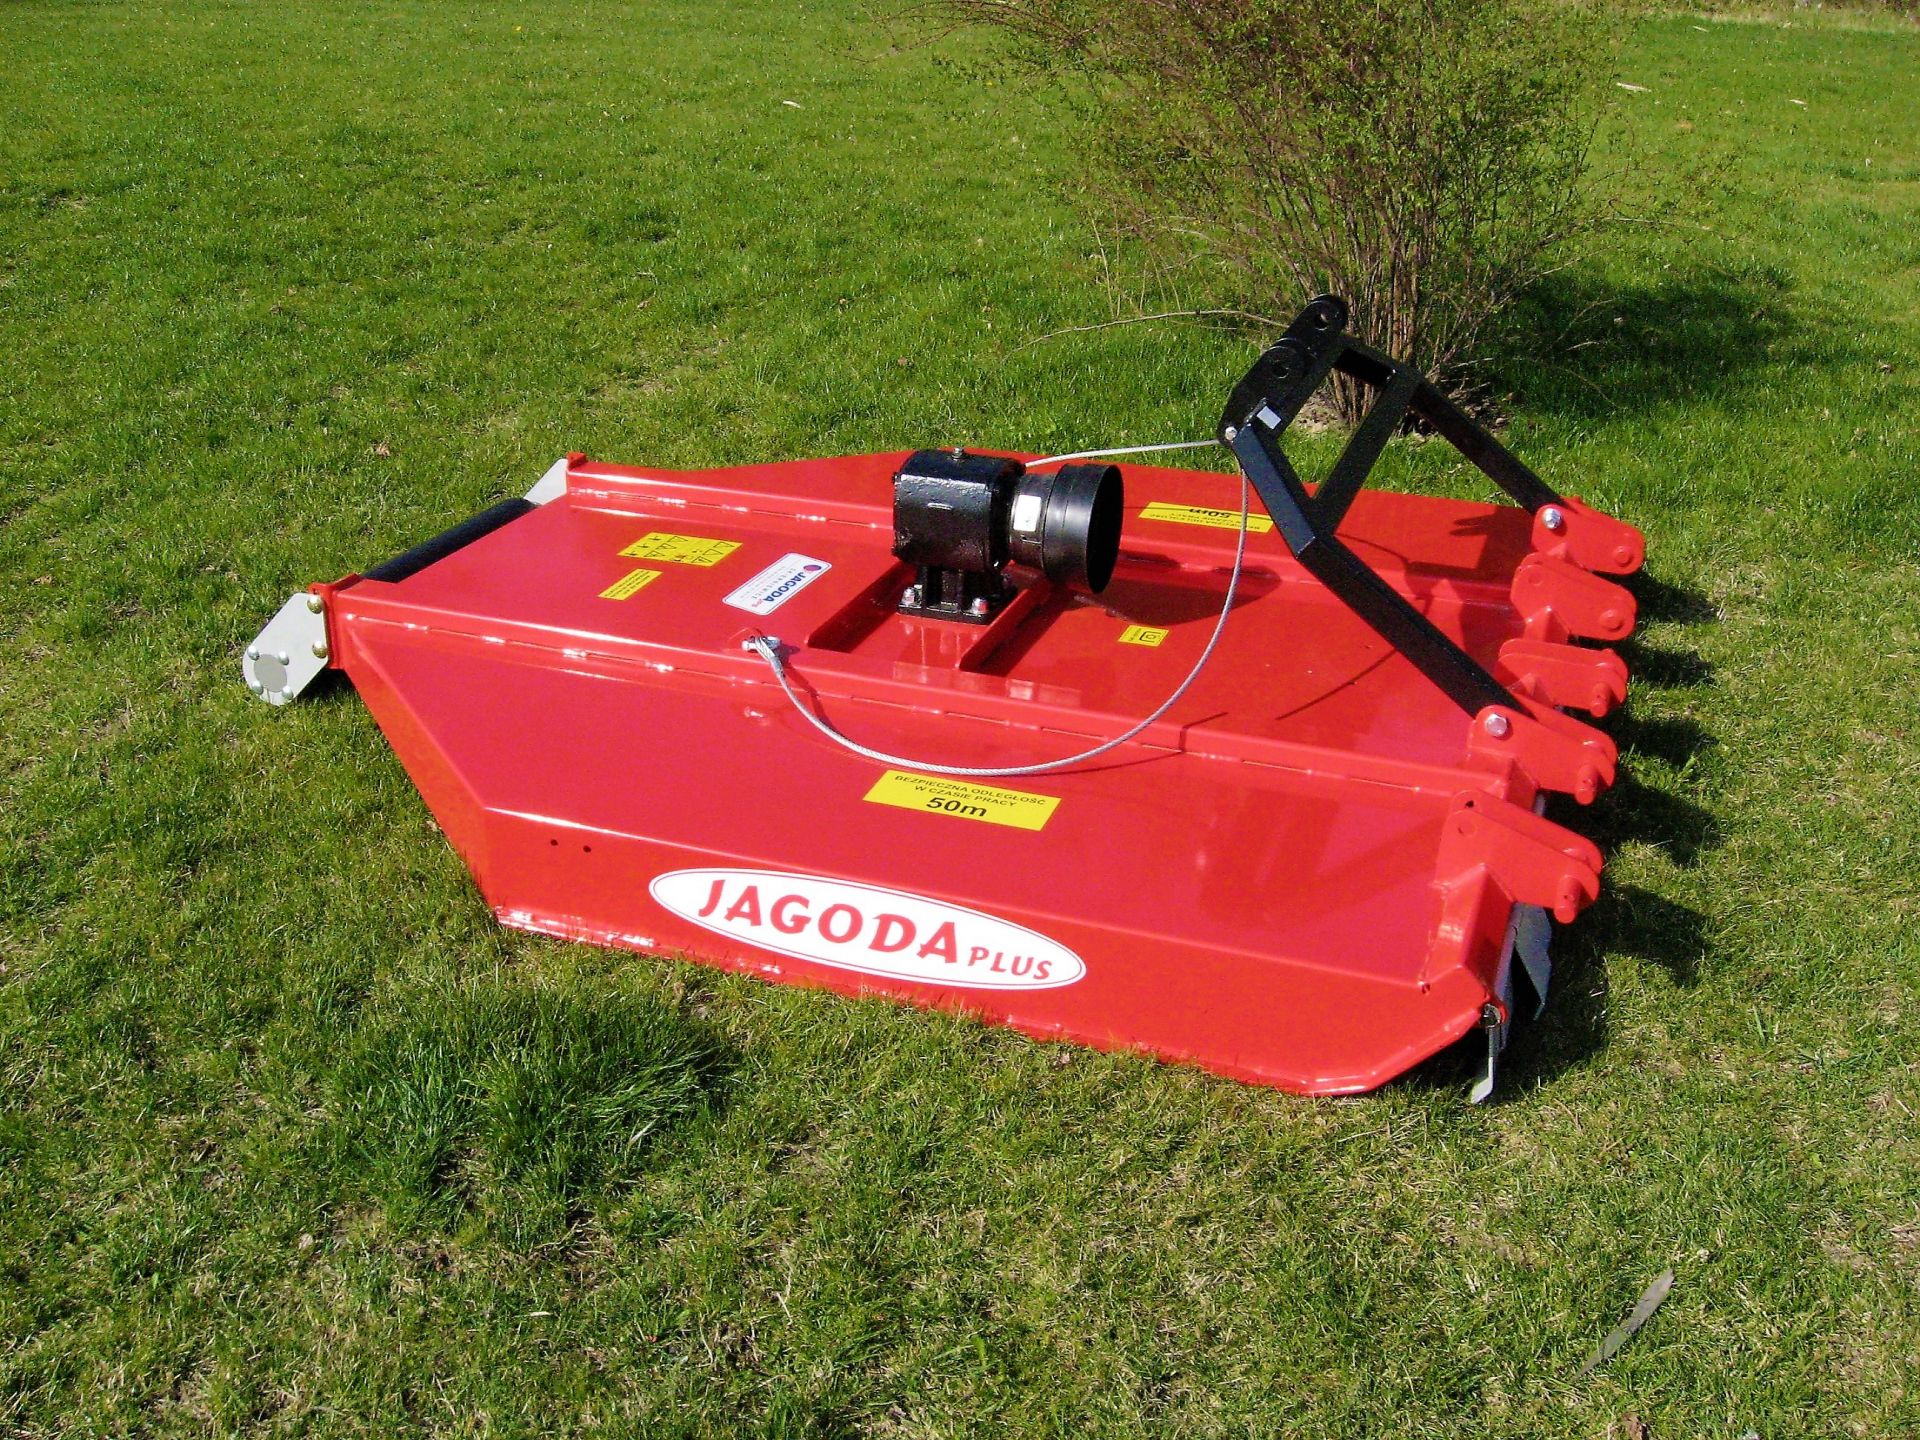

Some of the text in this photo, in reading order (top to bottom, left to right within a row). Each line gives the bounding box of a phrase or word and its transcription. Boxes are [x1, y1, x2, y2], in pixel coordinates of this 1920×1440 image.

[763, 571, 806, 602] JAGODA
[894, 775, 968, 792] BEZPIECZNA
[926, 796, 987, 817] 50m
[928, 787, 972, 800] CZASIE
[974, 794, 1017, 806] PRACY
[698, 879, 1053, 981] JAGODA PLUS
